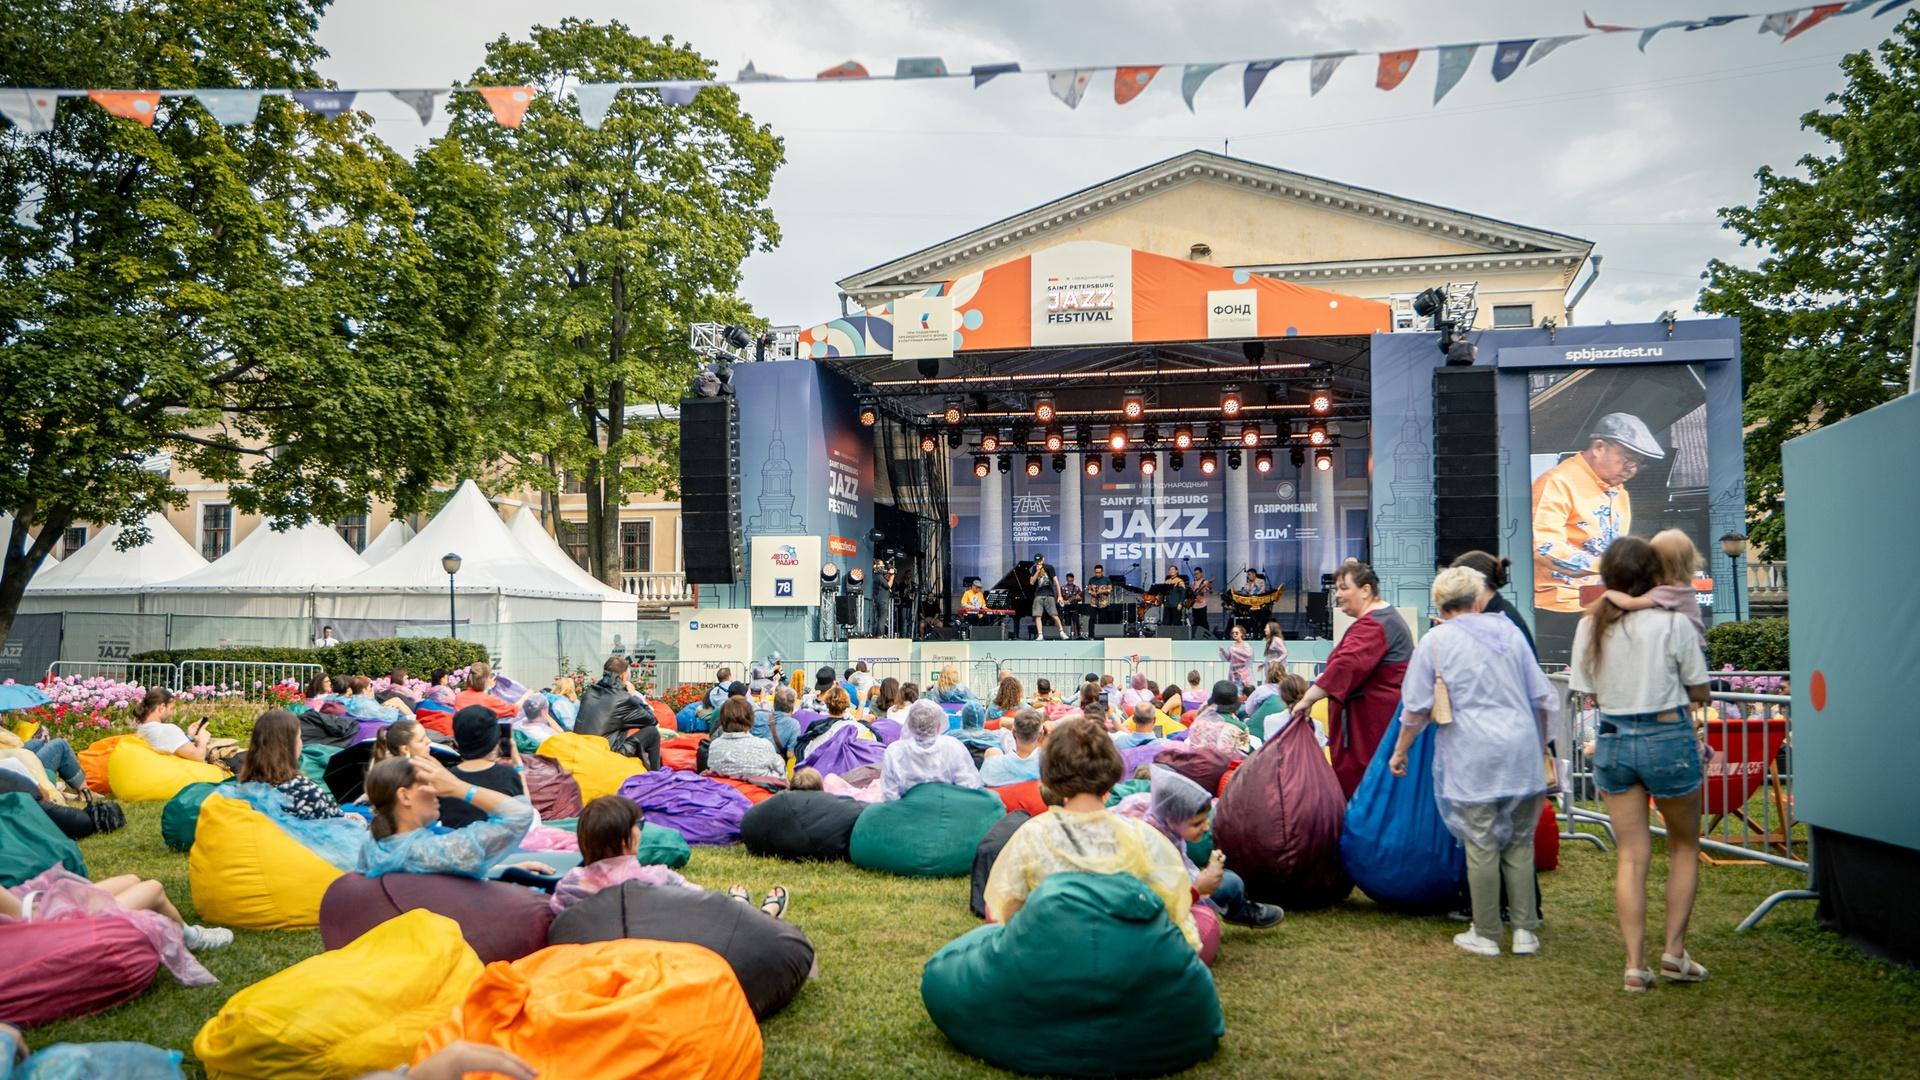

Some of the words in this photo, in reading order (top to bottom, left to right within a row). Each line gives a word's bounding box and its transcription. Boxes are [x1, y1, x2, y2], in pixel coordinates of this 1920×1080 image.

[1047, 290, 1115, 312] JAZZ
[1213, 304, 1251, 315] ФОНД
[1048, 311, 1113, 323] FESTIVAL
[1565, 346, 1663, 362] spbjazzfest.ru
[829, 470, 859, 501] JAZZ
[1100, 497, 1133, 506] SAINT
[1136, 495, 1209, 505] PETERSBURG
[828, 498, 858, 518] FESTIVAL
[1254, 503, 1318, 513] ГАЗПРОМБАНК
[1101, 508, 1209, 539] JAZZ
[1101, 542, 1209, 560] FESTIVAL
[777, 582, 791, 594] 78
[98, 645, 130, 658] JAZZ
